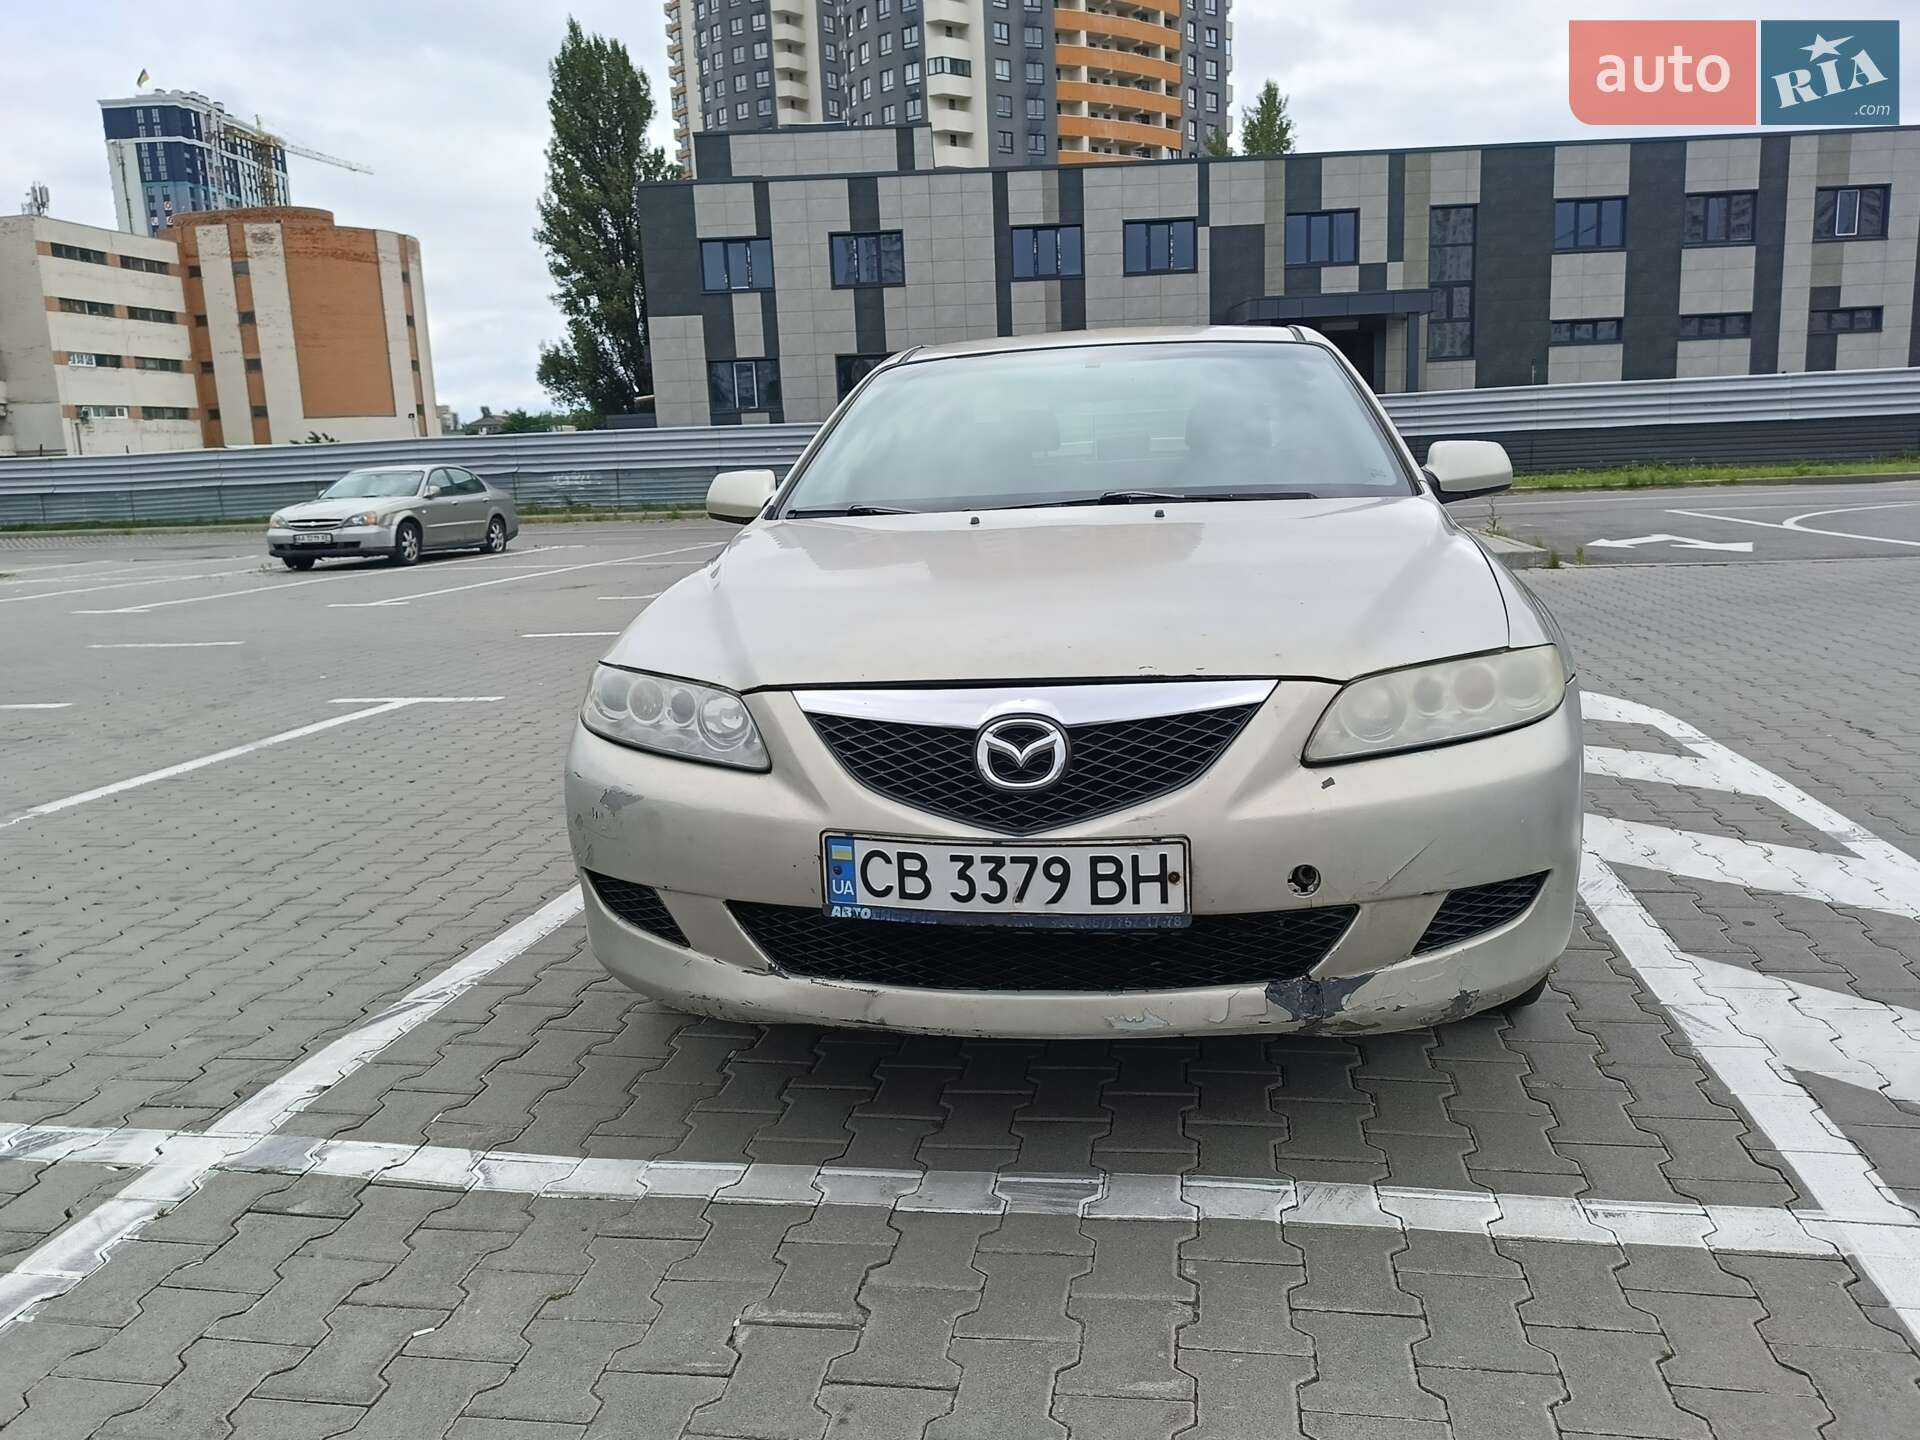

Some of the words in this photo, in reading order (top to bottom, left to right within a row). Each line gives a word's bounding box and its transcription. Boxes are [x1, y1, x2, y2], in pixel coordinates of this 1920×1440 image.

[832, 879, 855, 895] UA
[859, 849, 932, 901] CB
[949, 854, 1072, 905] 3379
[1089, 853, 1168, 905] BH
